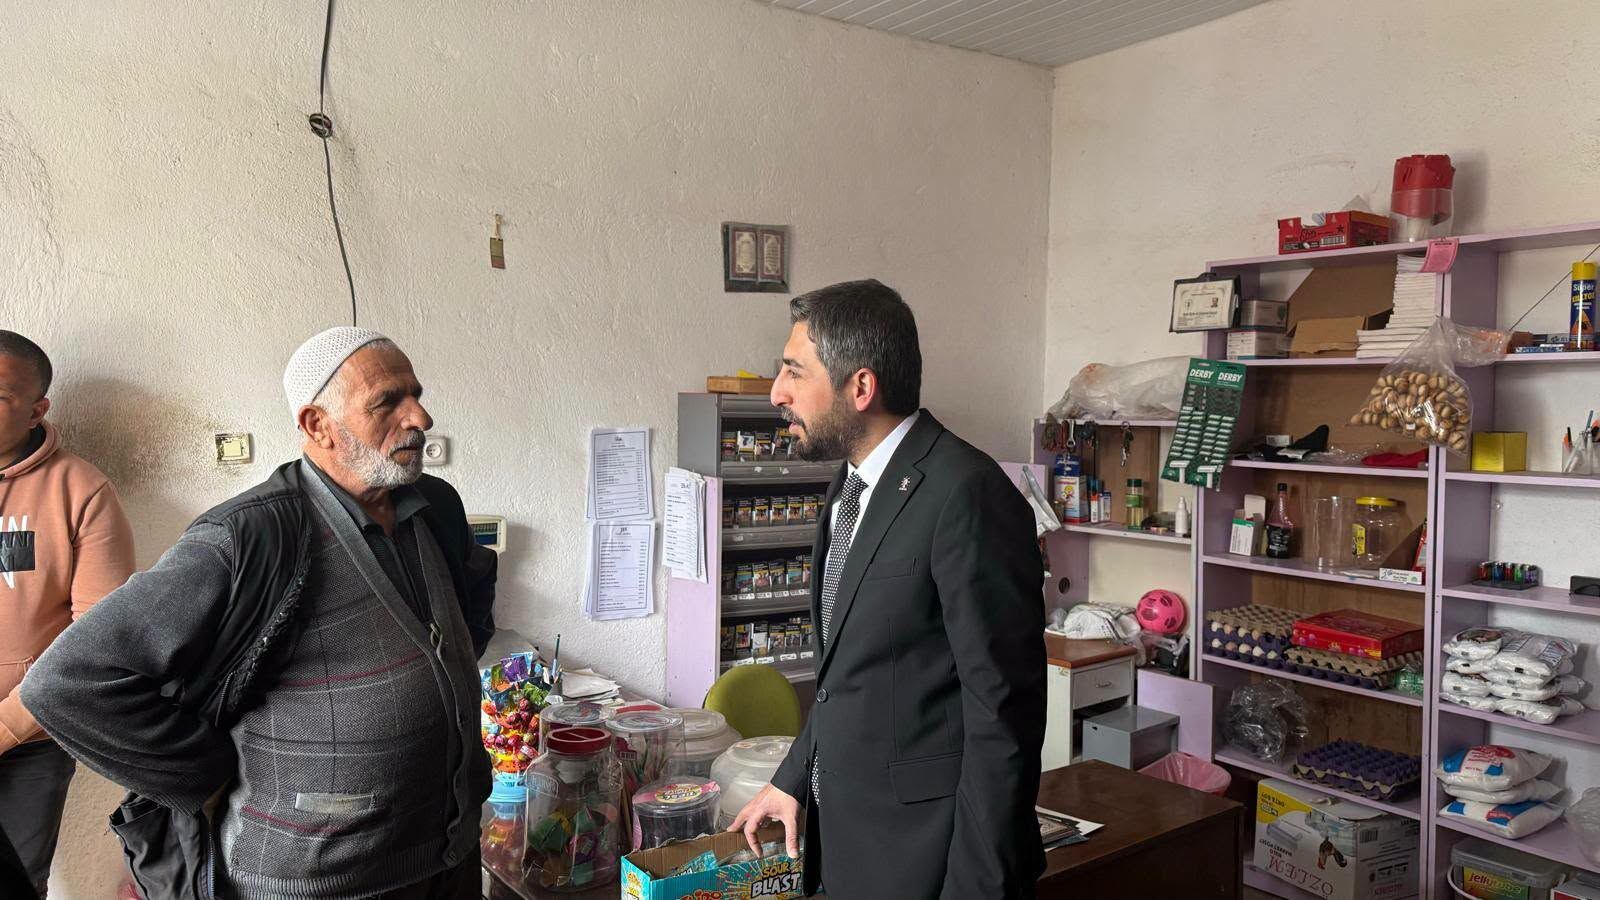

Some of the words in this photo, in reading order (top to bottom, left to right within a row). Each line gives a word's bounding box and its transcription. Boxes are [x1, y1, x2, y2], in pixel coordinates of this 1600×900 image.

[1189, 368, 1214, 379] DERBY
[1218, 372, 1242, 383] DERBY
[763, 861, 790, 877] SOUR
[1268, 855, 1334, 899] ÖZLEM
[751, 872, 801, 898] BLAST
